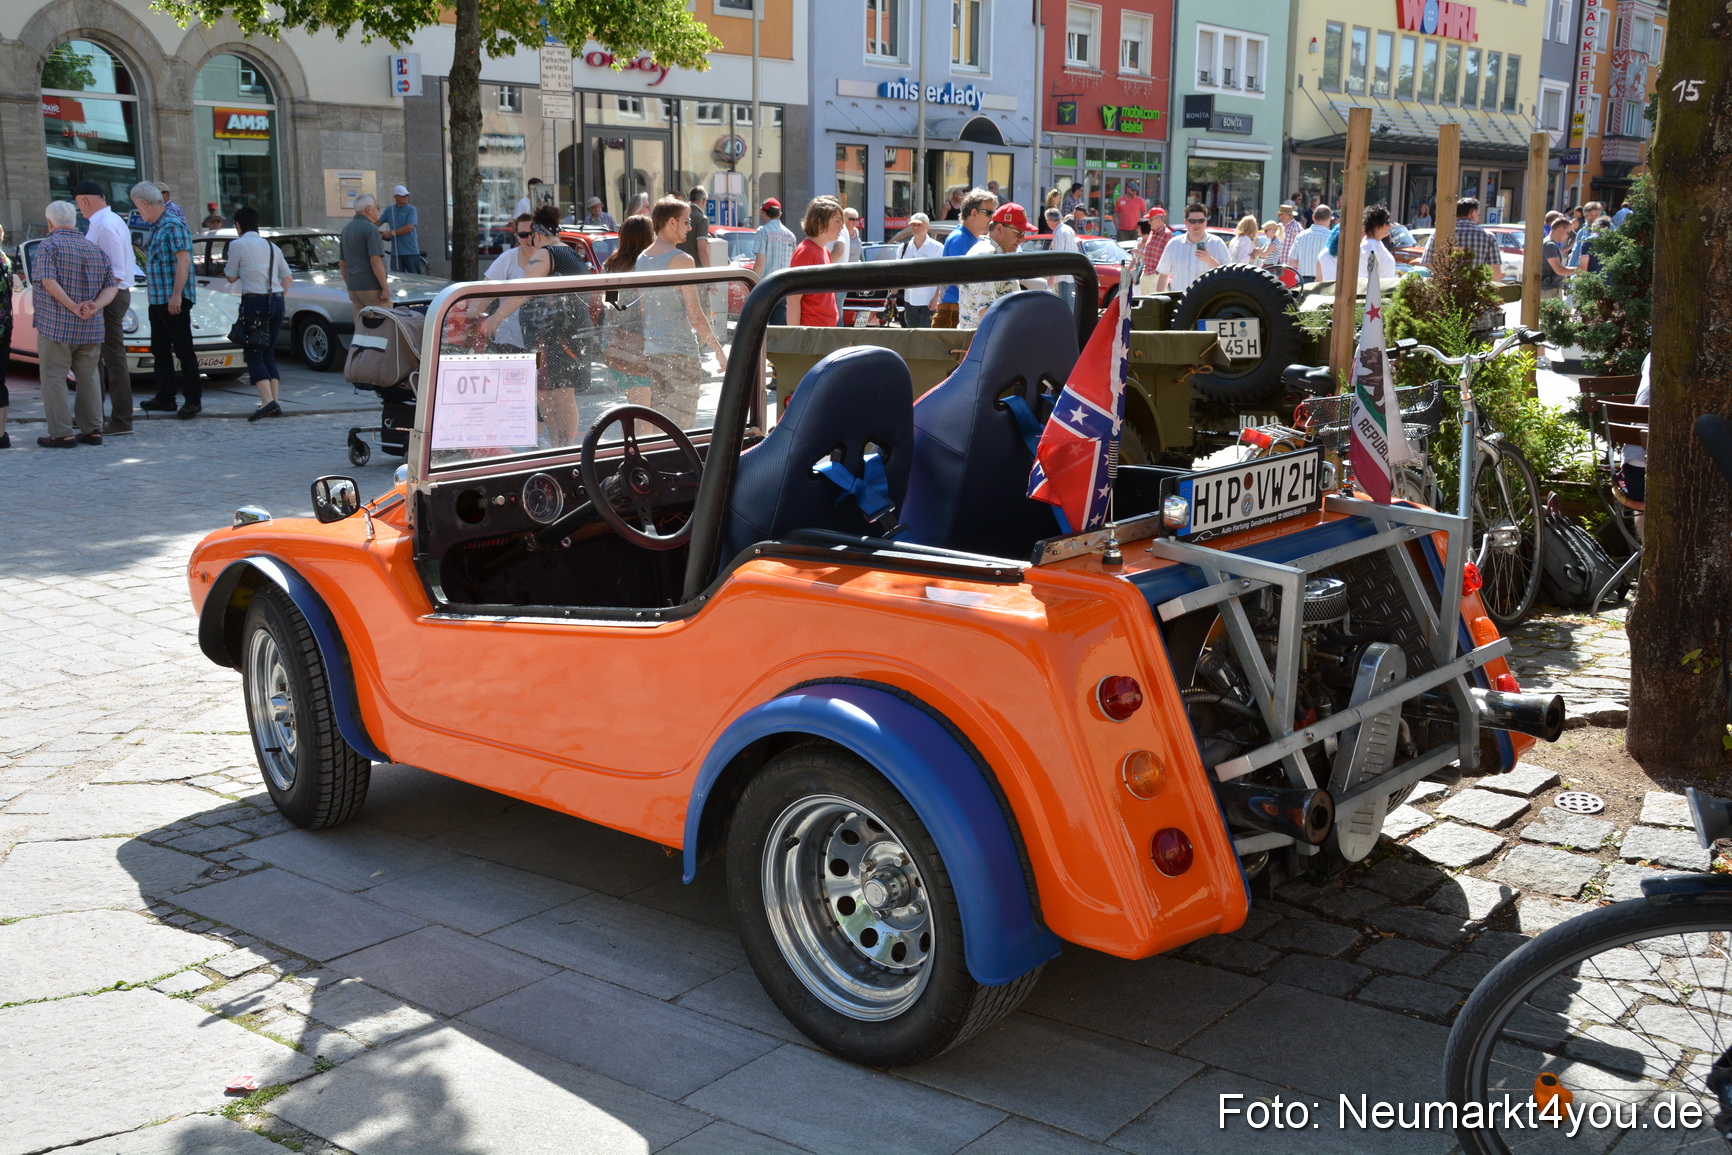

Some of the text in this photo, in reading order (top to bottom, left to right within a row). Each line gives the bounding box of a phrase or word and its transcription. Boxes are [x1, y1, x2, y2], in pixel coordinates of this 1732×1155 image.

[1579, 0, 1597, 110] BÄCKEREI
[951, 82, 985, 111] lady
[1671, 79, 1706, 103] 15
[1121, 105, 1160, 120] mobilcom
[1121, 120, 1143, 133] debitel
[1219, 322, 1237, 338] EI
[1193, 476, 1241, 527] HIP
[1221, 525, 1233, 535] Auto
[1232, 521, 1250, 533] Hartung
